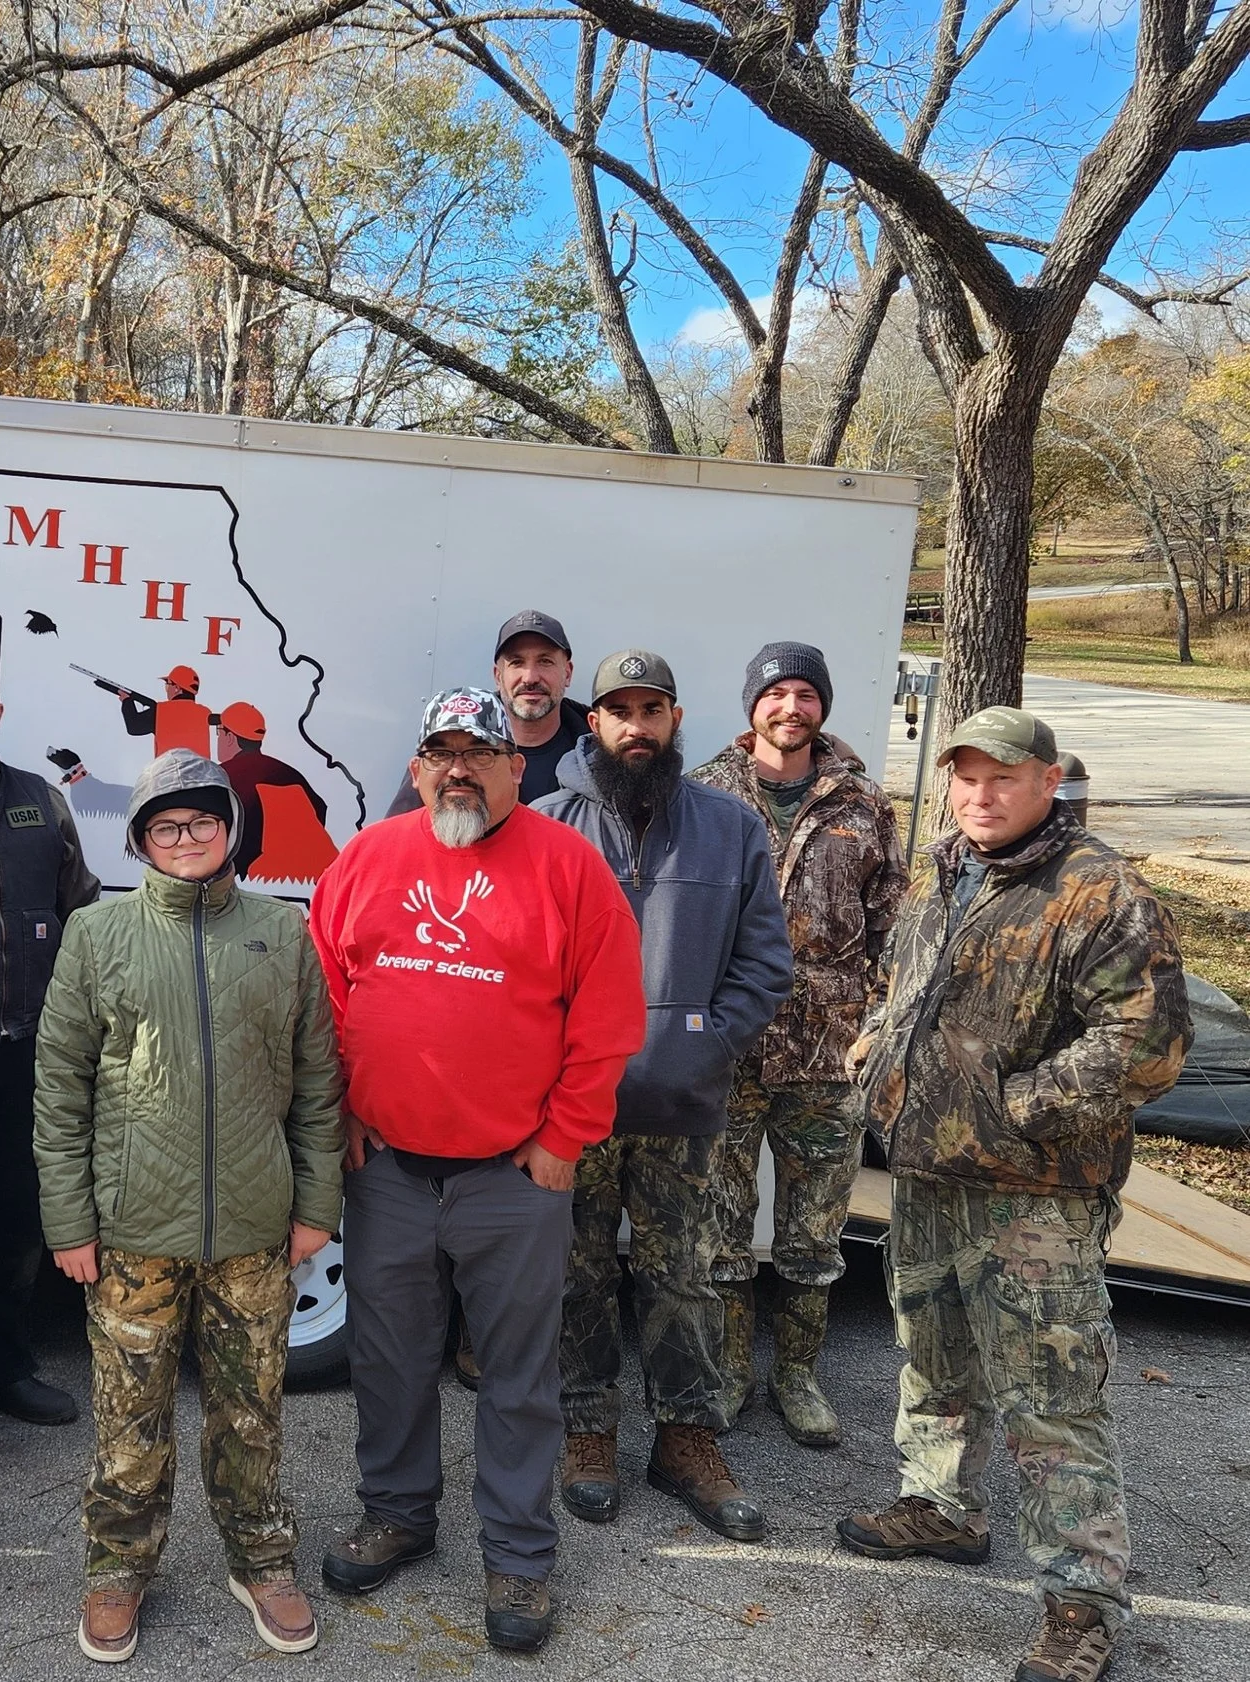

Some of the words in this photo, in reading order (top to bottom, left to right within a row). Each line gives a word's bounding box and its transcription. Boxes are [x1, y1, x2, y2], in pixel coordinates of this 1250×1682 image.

[448, 698, 476, 710] PICO
[10, 809, 39, 823] USAF
[375, 952, 433, 971] brewer
[435, 961, 505, 983] science
